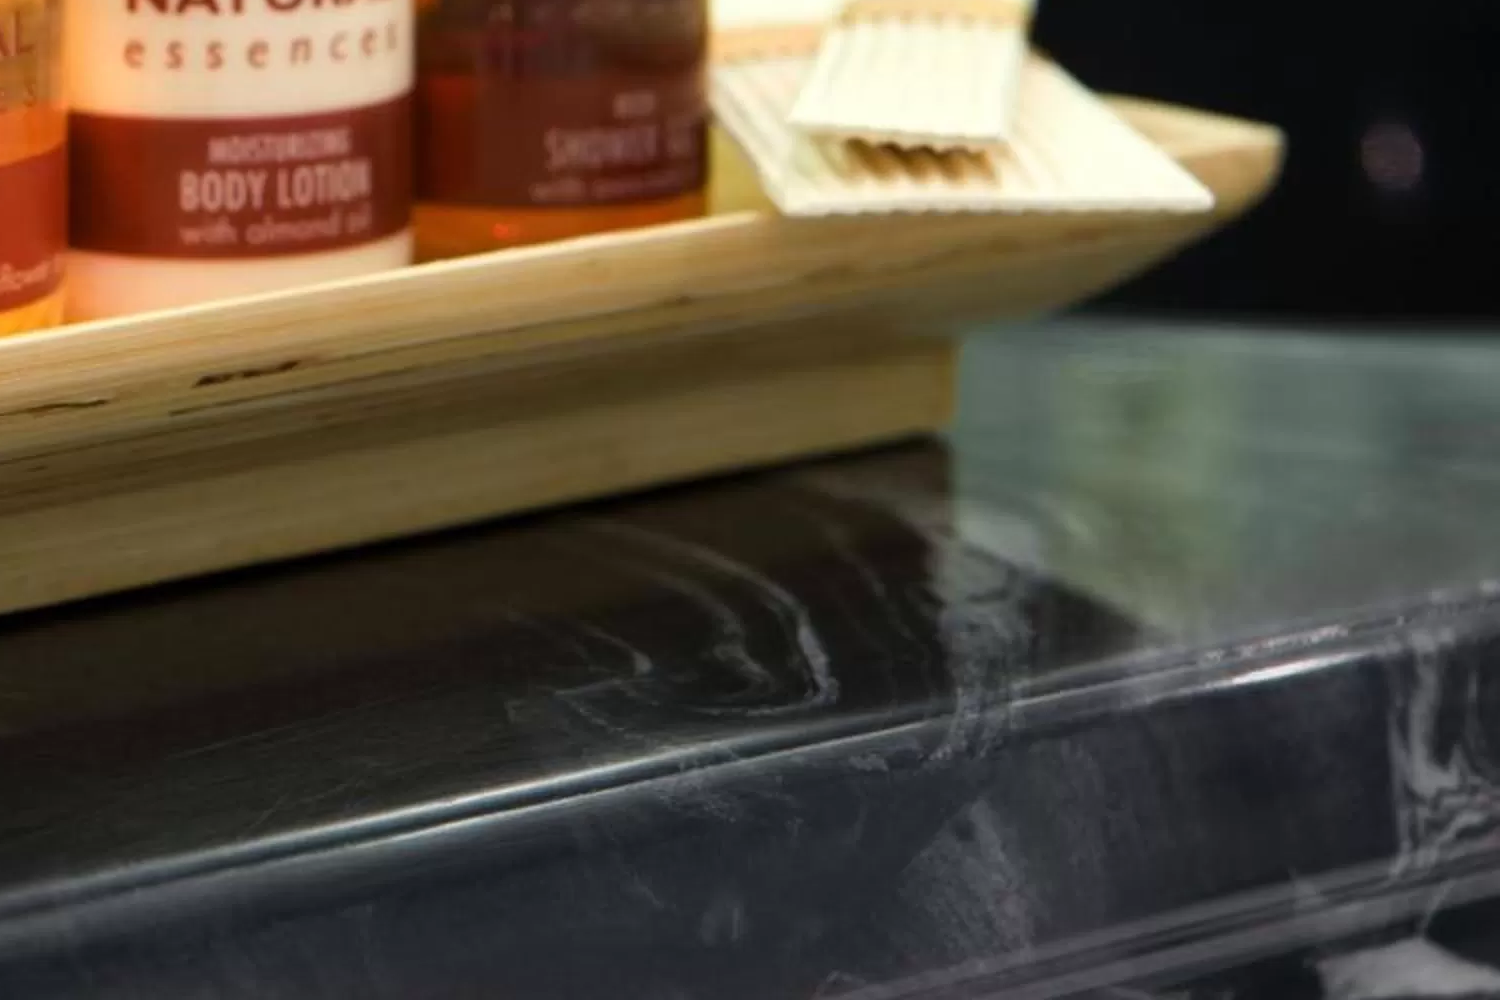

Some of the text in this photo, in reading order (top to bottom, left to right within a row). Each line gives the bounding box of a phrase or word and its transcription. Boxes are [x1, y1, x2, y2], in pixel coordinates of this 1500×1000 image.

[179, 159, 373, 213] BODY LOTION
[180, 213, 238, 245] with
[244, 210, 340, 244] almond
